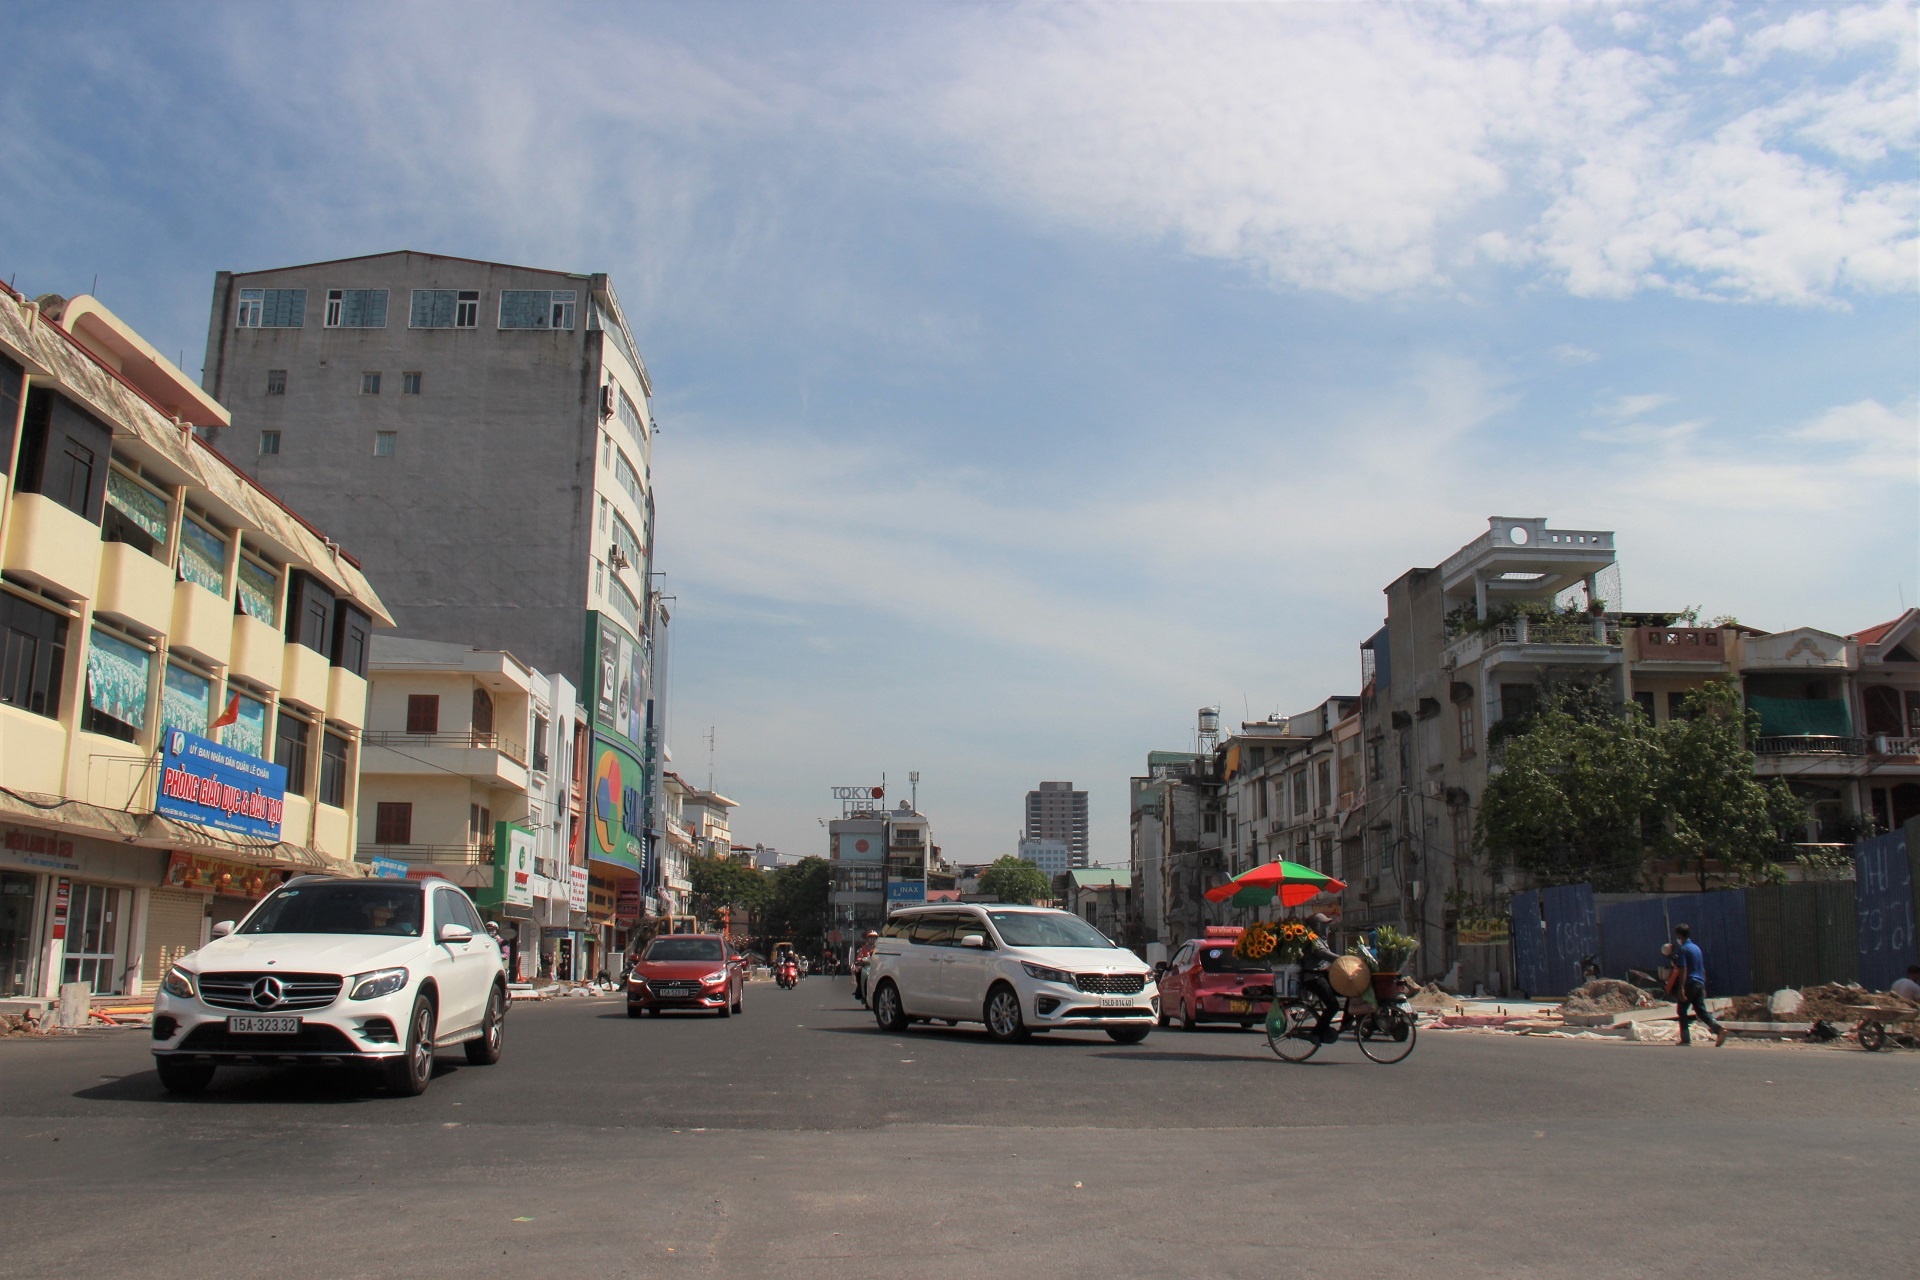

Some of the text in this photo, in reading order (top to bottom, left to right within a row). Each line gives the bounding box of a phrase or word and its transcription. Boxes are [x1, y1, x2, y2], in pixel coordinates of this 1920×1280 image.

[198, 747, 210, 759] BAN
[210, 750, 224, 764] NHÂN
[225, 755, 236, 767] DÂN
[256, 767, 270, 780] CHÂN
[163, 763, 200, 802] PHÒNG
[199, 773, 223, 808] GIÁO
[221, 783, 241, 819] DỤC
[240, 790, 250, 816] &
[249, 787, 268, 820] ĐÀO
[267, 796, 284, 829] TẠO
[233, 1018, 296, 1032] 15A-323.32
